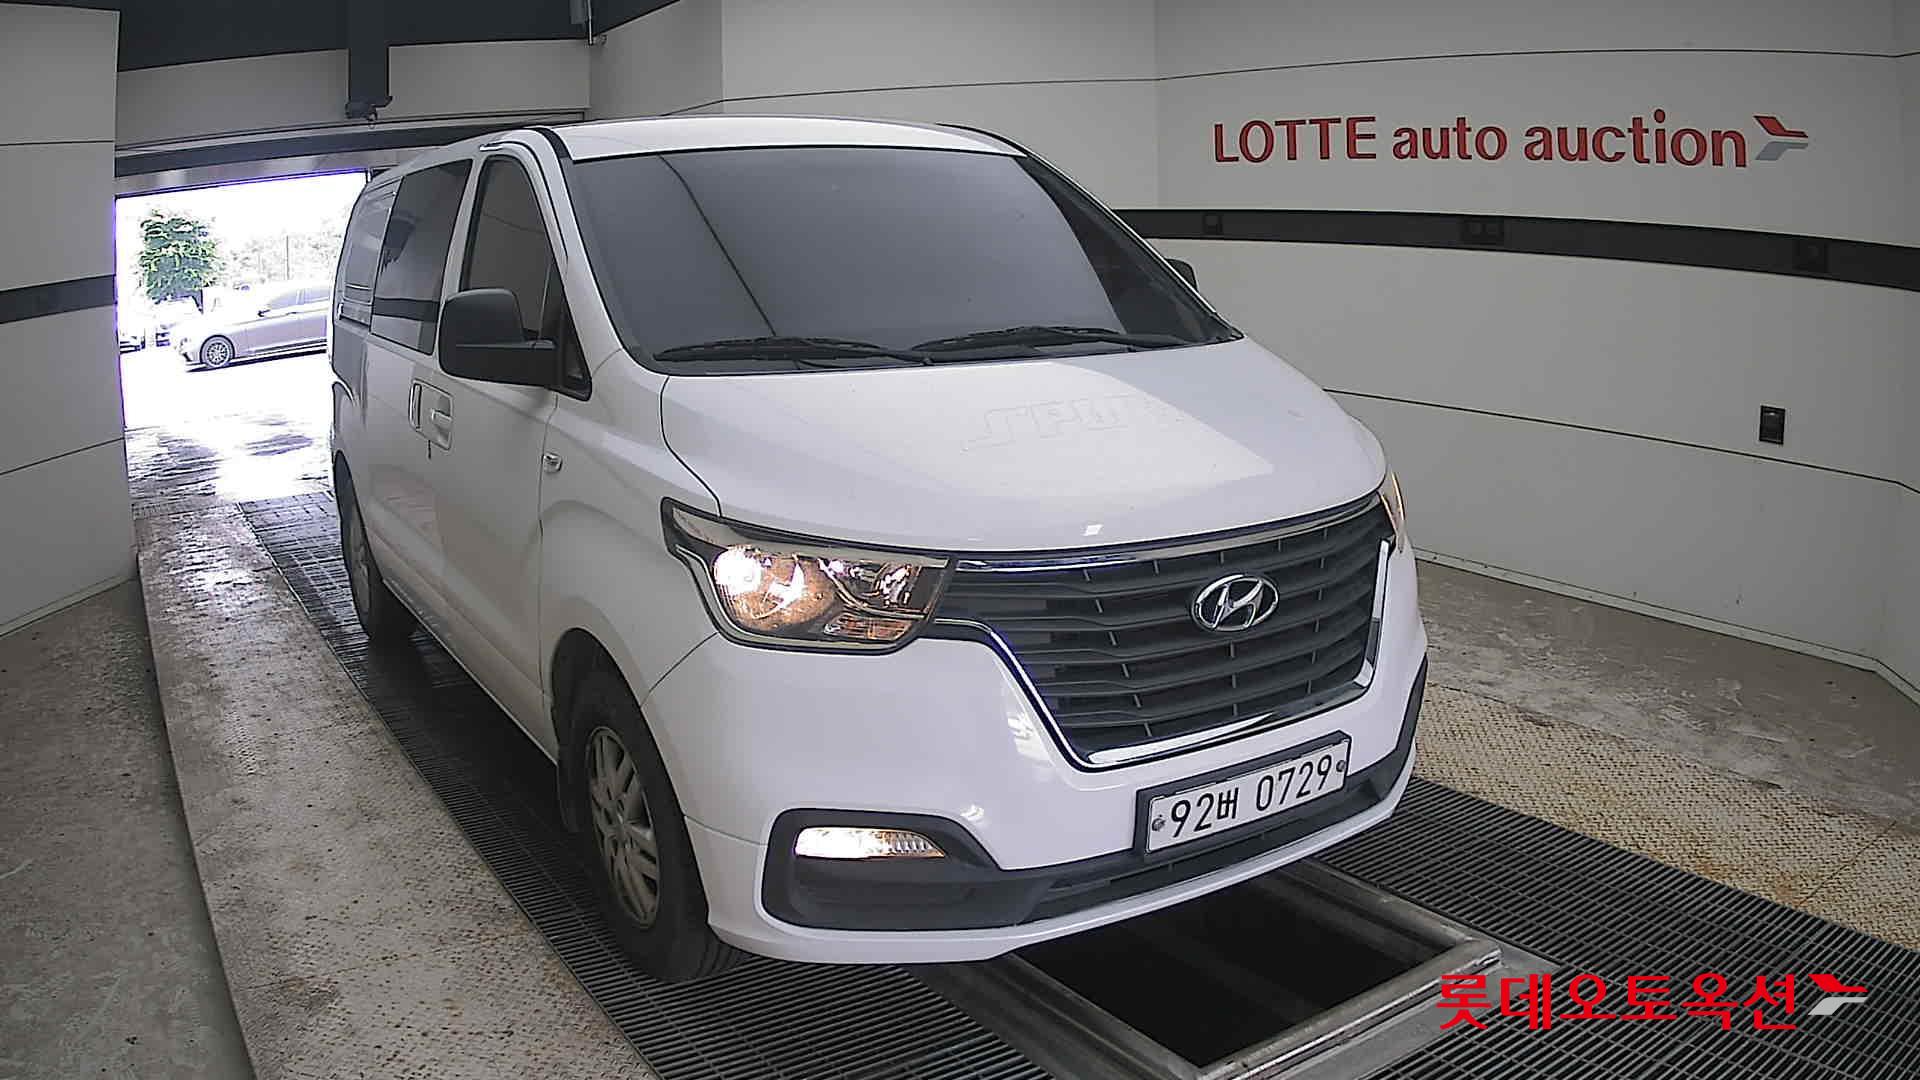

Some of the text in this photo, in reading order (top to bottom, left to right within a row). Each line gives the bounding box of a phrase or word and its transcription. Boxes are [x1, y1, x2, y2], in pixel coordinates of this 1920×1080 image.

[1213, 108, 1747, 168] LOTTE auto auction
[1170, 754, 1333, 838] 92버 0729
